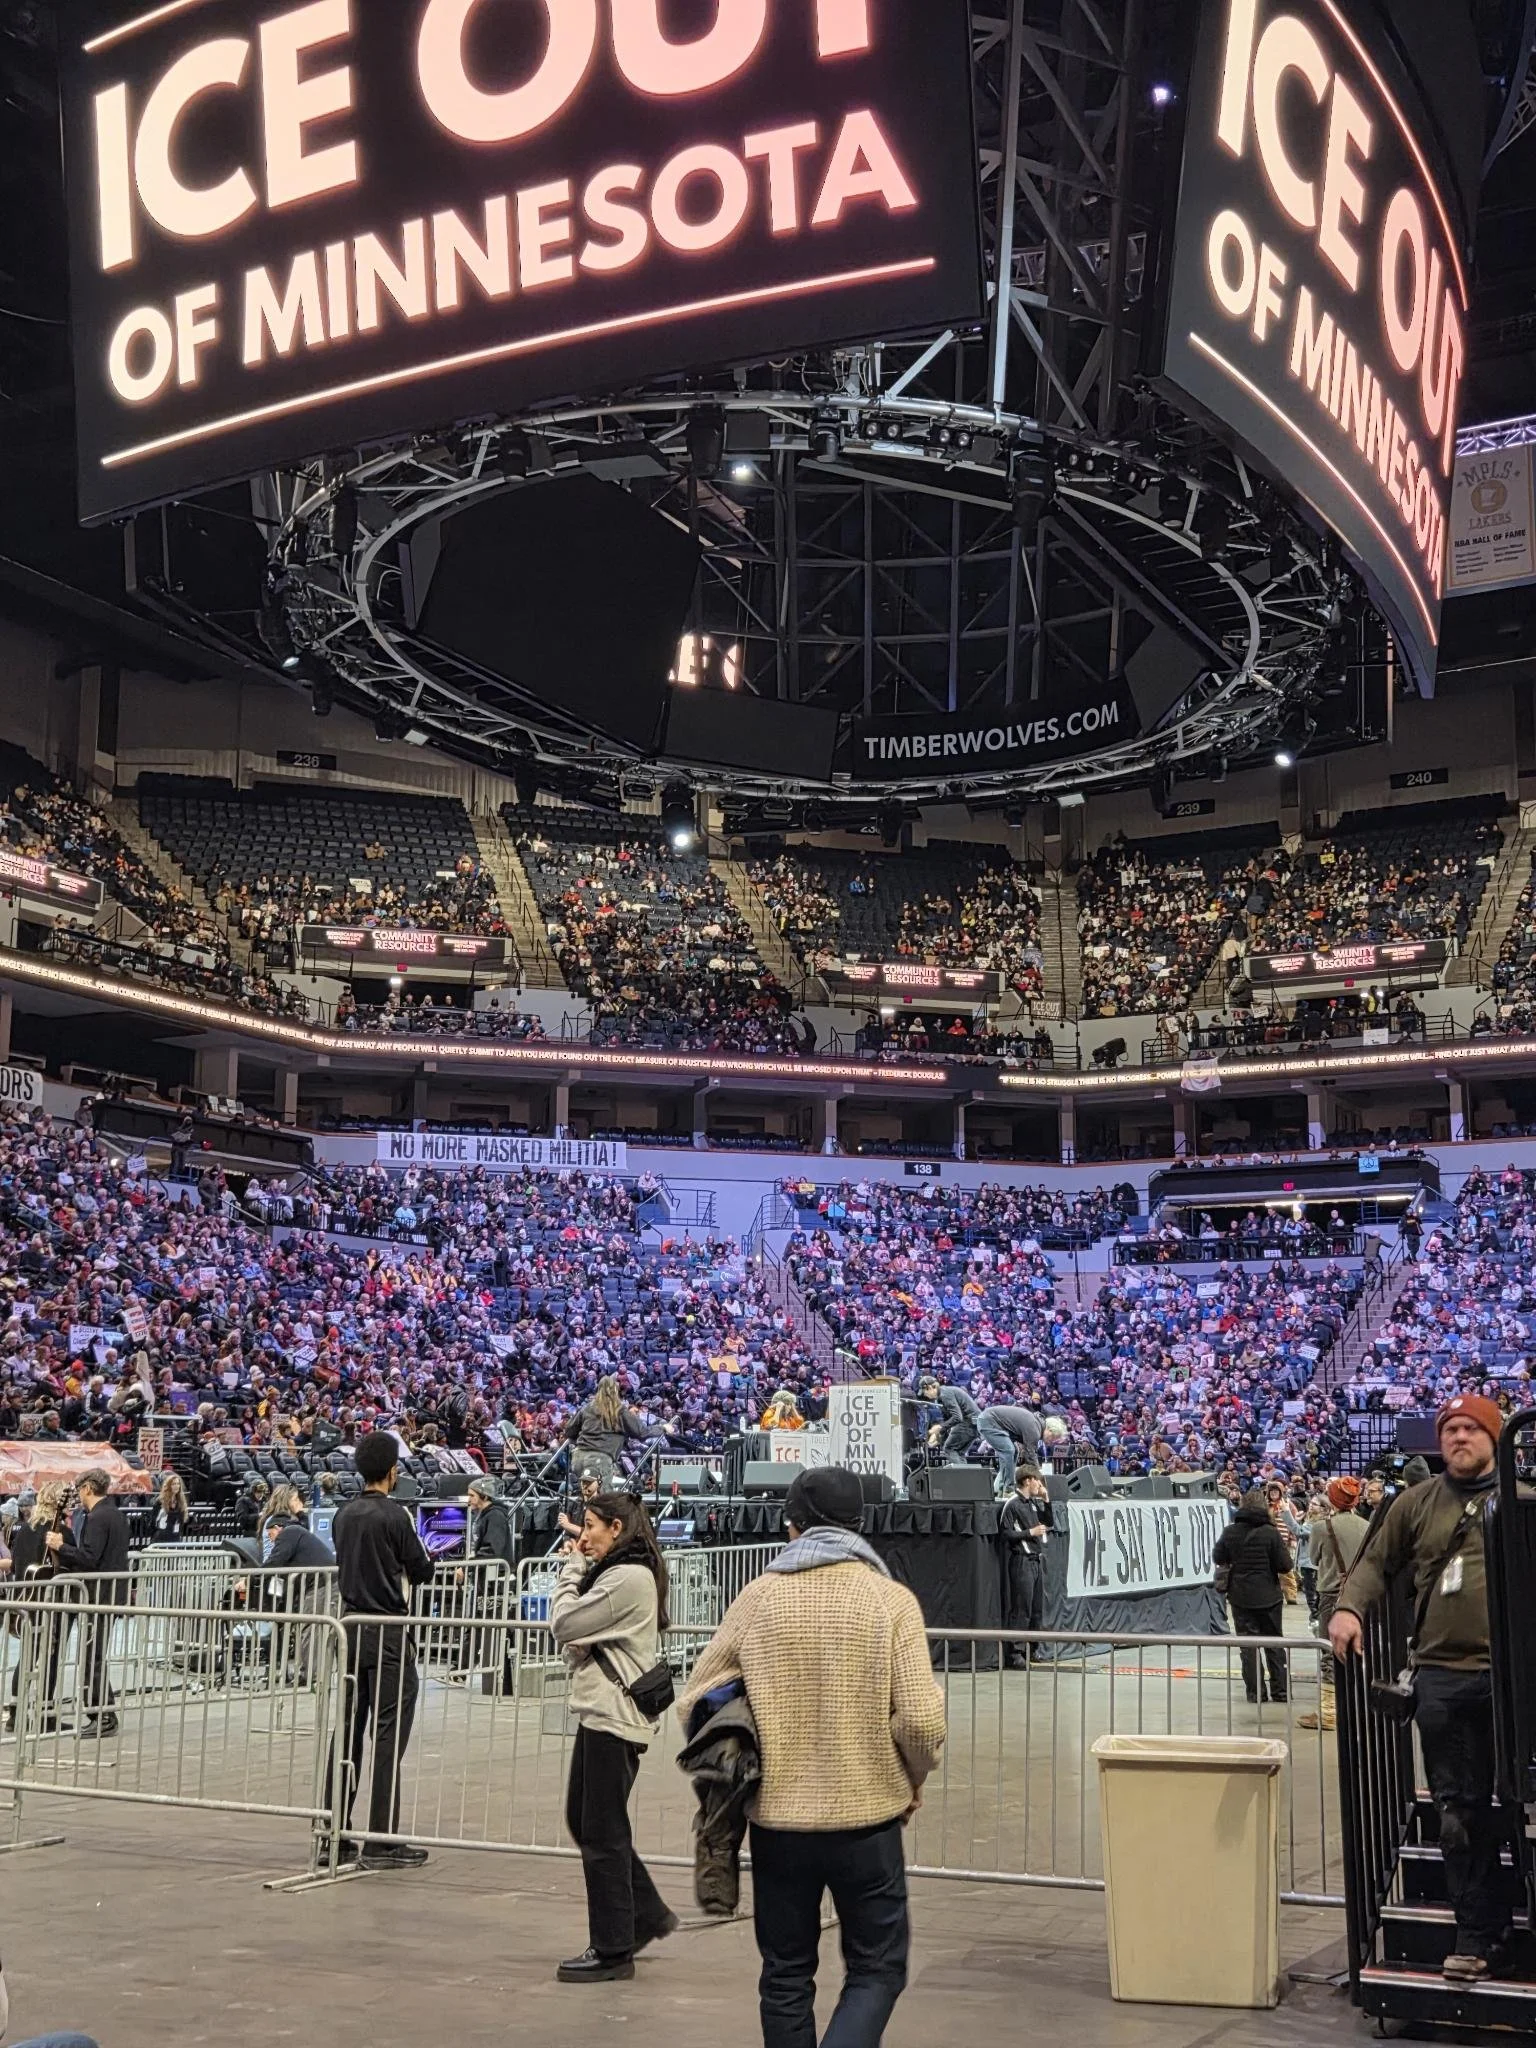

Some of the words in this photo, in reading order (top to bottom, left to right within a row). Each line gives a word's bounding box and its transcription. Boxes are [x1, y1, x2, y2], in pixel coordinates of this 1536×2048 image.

[95, 0, 358, 271] ICE
[1218, 0, 1373, 292] ICE
[1381, 188, 1466, 477] OUT
[109, 283, 217, 401] OF
[243, 109, 918, 367] MINNESOTA
[1207, 210, 1287, 342] OF
[1290, 286, 1446, 582] MINNESOTA
[1462, 460, 1514, 488] MPLS
[1472, 536, 1491, 545] HALL
[1492, 533, 1502, 542] OF
[1504, 529, 1527, 540] FAME
[864, 701, 1119, 759] TIMBERWOLVES.COM
[293, 754, 320, 767] 236
[1406, 771, 1432, 786] 240
[1176, 803, 1200, 816] 239
[372, 930, 437, 944] COMMUNITY
[375, 940, 437, 953] RESOURCES
[882, 964, 940, 977] COMMUNITY
[1315, 956, 1375, 970] RESOURCES
[885, 974, 940, 986] RESOURCES
[1033, 1001, 1045, 1011] ICE
[1046, 1002, 1060, 1012] OUT
[376, 1042, 392, 1051] ANY
[393, 1043, 420, 1052] PEOPLE
[420, 1045, 438, 1053] WILL
[439, 1046, 467, 1055] QUIETLY
[469, 1048, 494, 1056] SUBMIT
[506, 1049, 522, 1058] AND
[522, 1050, 538, 1058] YOU
[538, 1051, 557, 1060] HAVE
[558, 1052, 583, 1061] FOUND
[584, 1053, 599, 1062] OUT
[599, 1055, 611, 1063] THE
[612, 1055, 634, 1063] EXACT
[635, 1056, 668, 1065] MEASURE
[678, 1058, 711, 1067] INJUSTICE
[711, 1060, 727, 1068] AND
[727, 1061, 754, 1070] WRONG
[754, 1063, 777, 1071] WHICH
[777, 1064, 793, 1072] WILL
[802, 1065, 832, 1073] IMPOSED
[832, 1067, 851, 1075] UPON
[1248, 1062, 1279, 1073] WITHOUT
[1325, 1057, 1349, 1067] NEVER
[1348, 1057, 1361, 1065] DID
[1361, 1055, 1378, 1064] AND
[1385, 1053, 1410, 1063] NEVER
[1434, 1050, 1452, 1059] FIND
[1452, 1048, 1469, 1058] OUT
[1469, 1047, 1486, 1057] JUST
[1486, 1045, 1509, 1055] WHAT
[1509, 1044, 1525, 1053] ANY
[1035, 1077, 1046, 1085] NO
[1105, 1075, 1117, 1084] NO
[390, 1133, 414, 1159] NO
[422, 1135, 468, 1160] MORE
[477, 1137, 542, 1164] MASKED
[549, 1141, 617, 1167] MILITIA!
[913, 1164, 932, 1174] 138
[845, 1395, 875, 1411] ICE
[839, 1411, 880, 1427] OUT
[849, 1428, 873, 1443] OF
[140, 1439, 159, 1454] ICE
[845, 1443, 876, 1459] MN
[140, 1454, 161, 1469] OUT!
[835, 1460, 887, 1475] NOW!
[1080, 1508, 1110, 1588] WE
[1113, 1507, 1148, 1585] SAY
[1151, 1505, 1184, 1581] ICE
